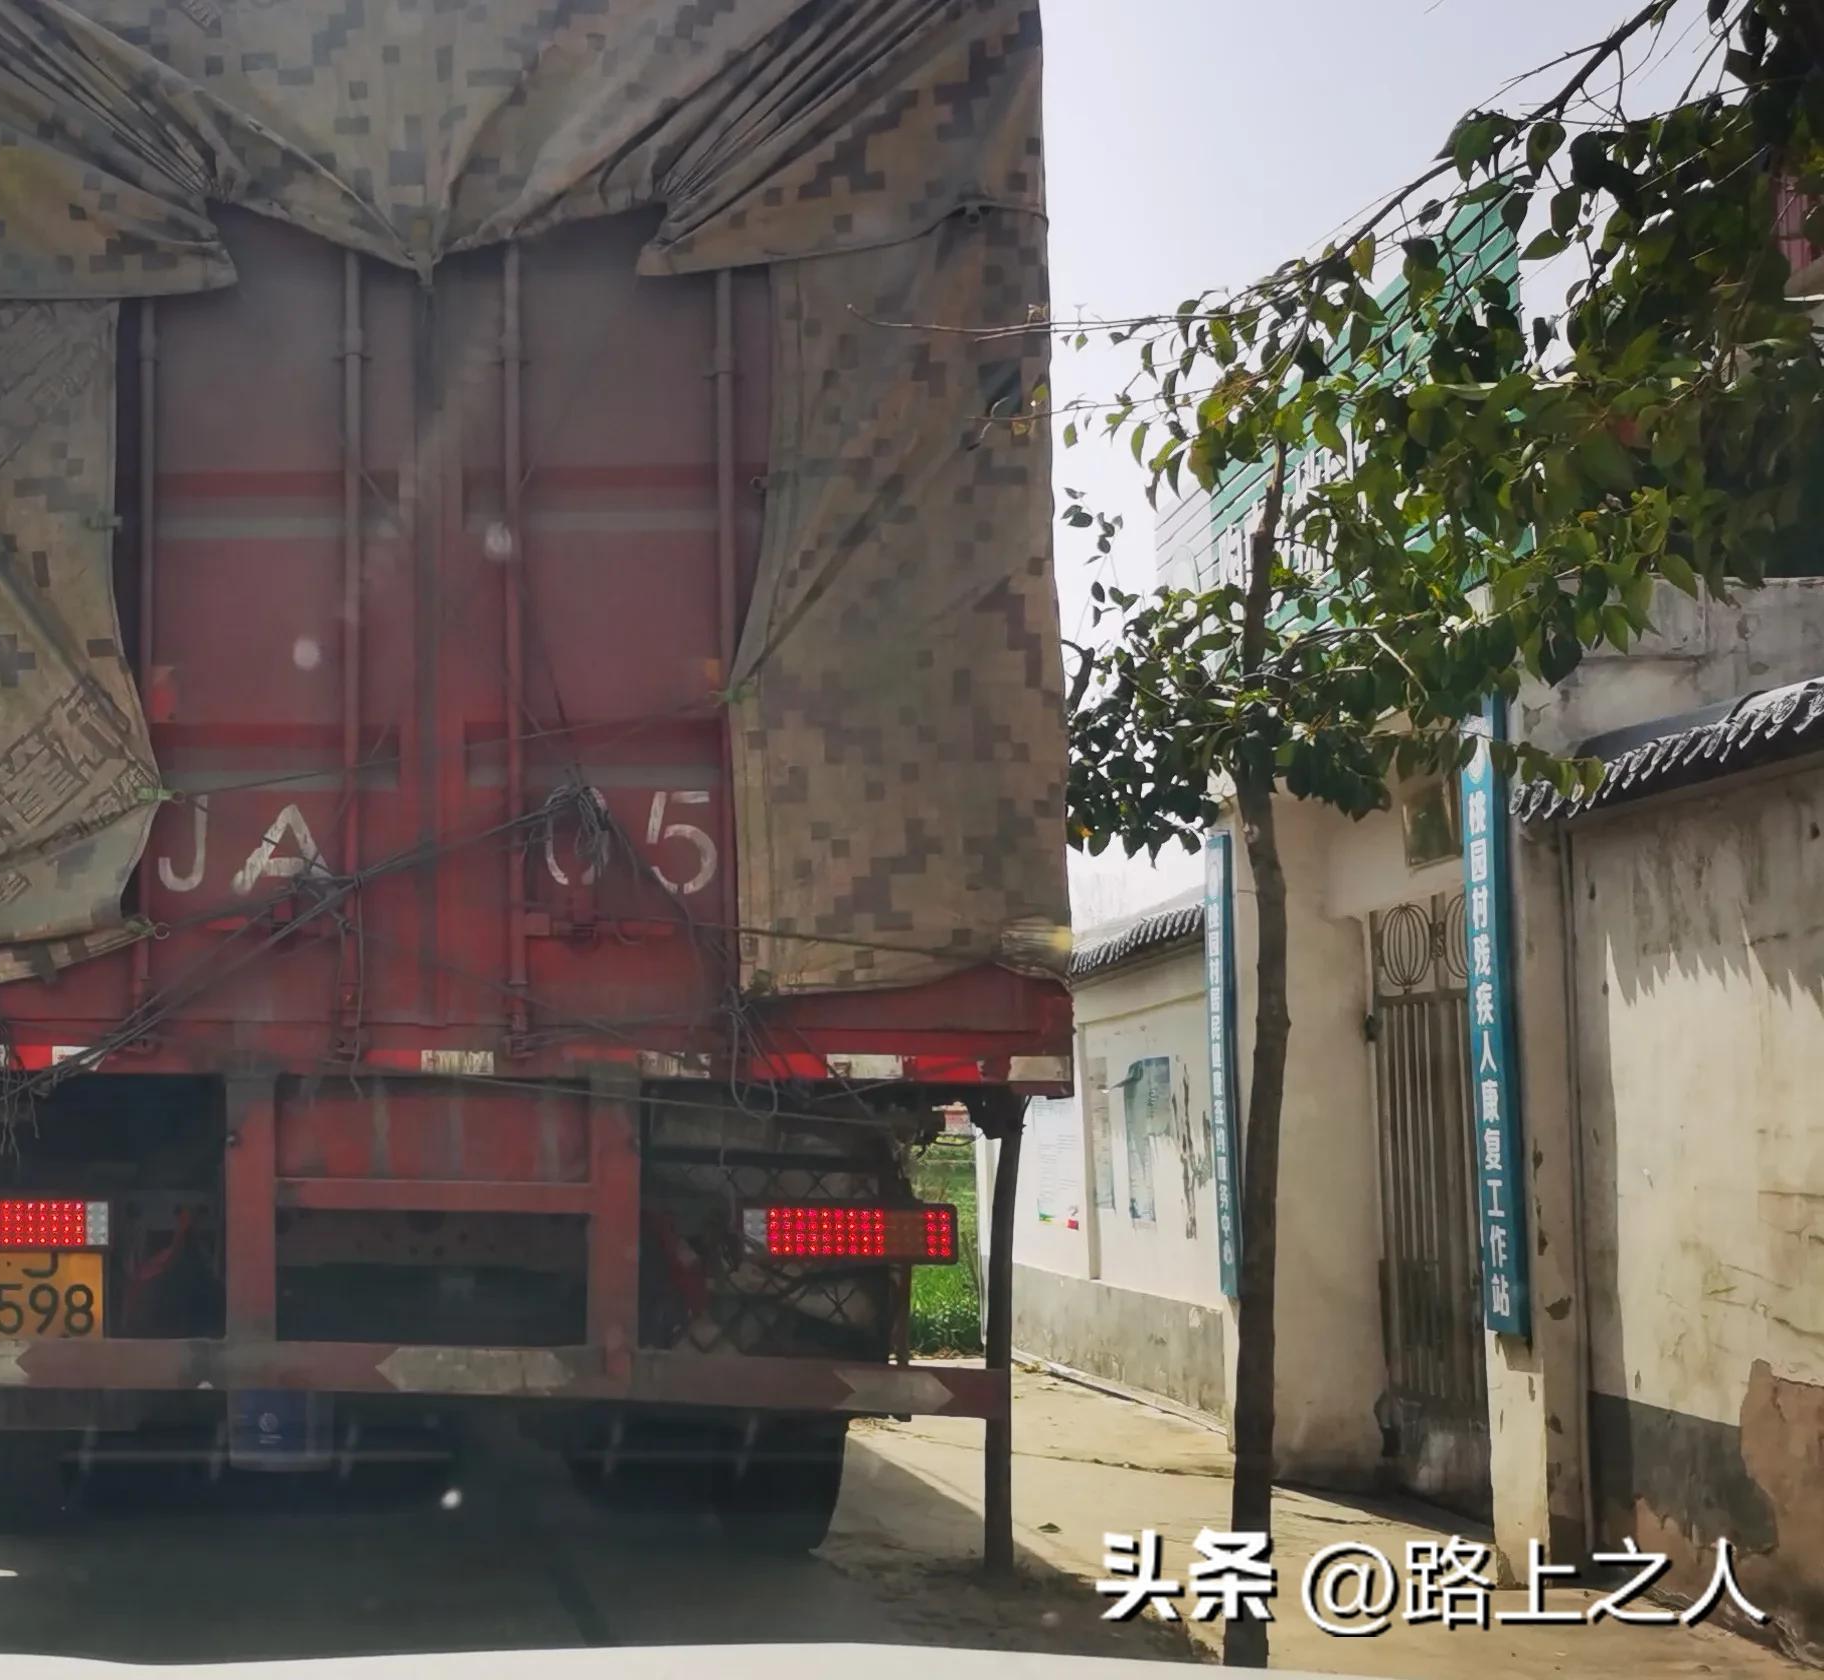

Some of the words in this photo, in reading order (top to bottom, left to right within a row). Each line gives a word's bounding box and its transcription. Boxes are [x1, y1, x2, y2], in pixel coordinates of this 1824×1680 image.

[158, 794, 334, 895] JA
[1467, 790, 1512, 1318] 桃园村残疾人康复工作站
